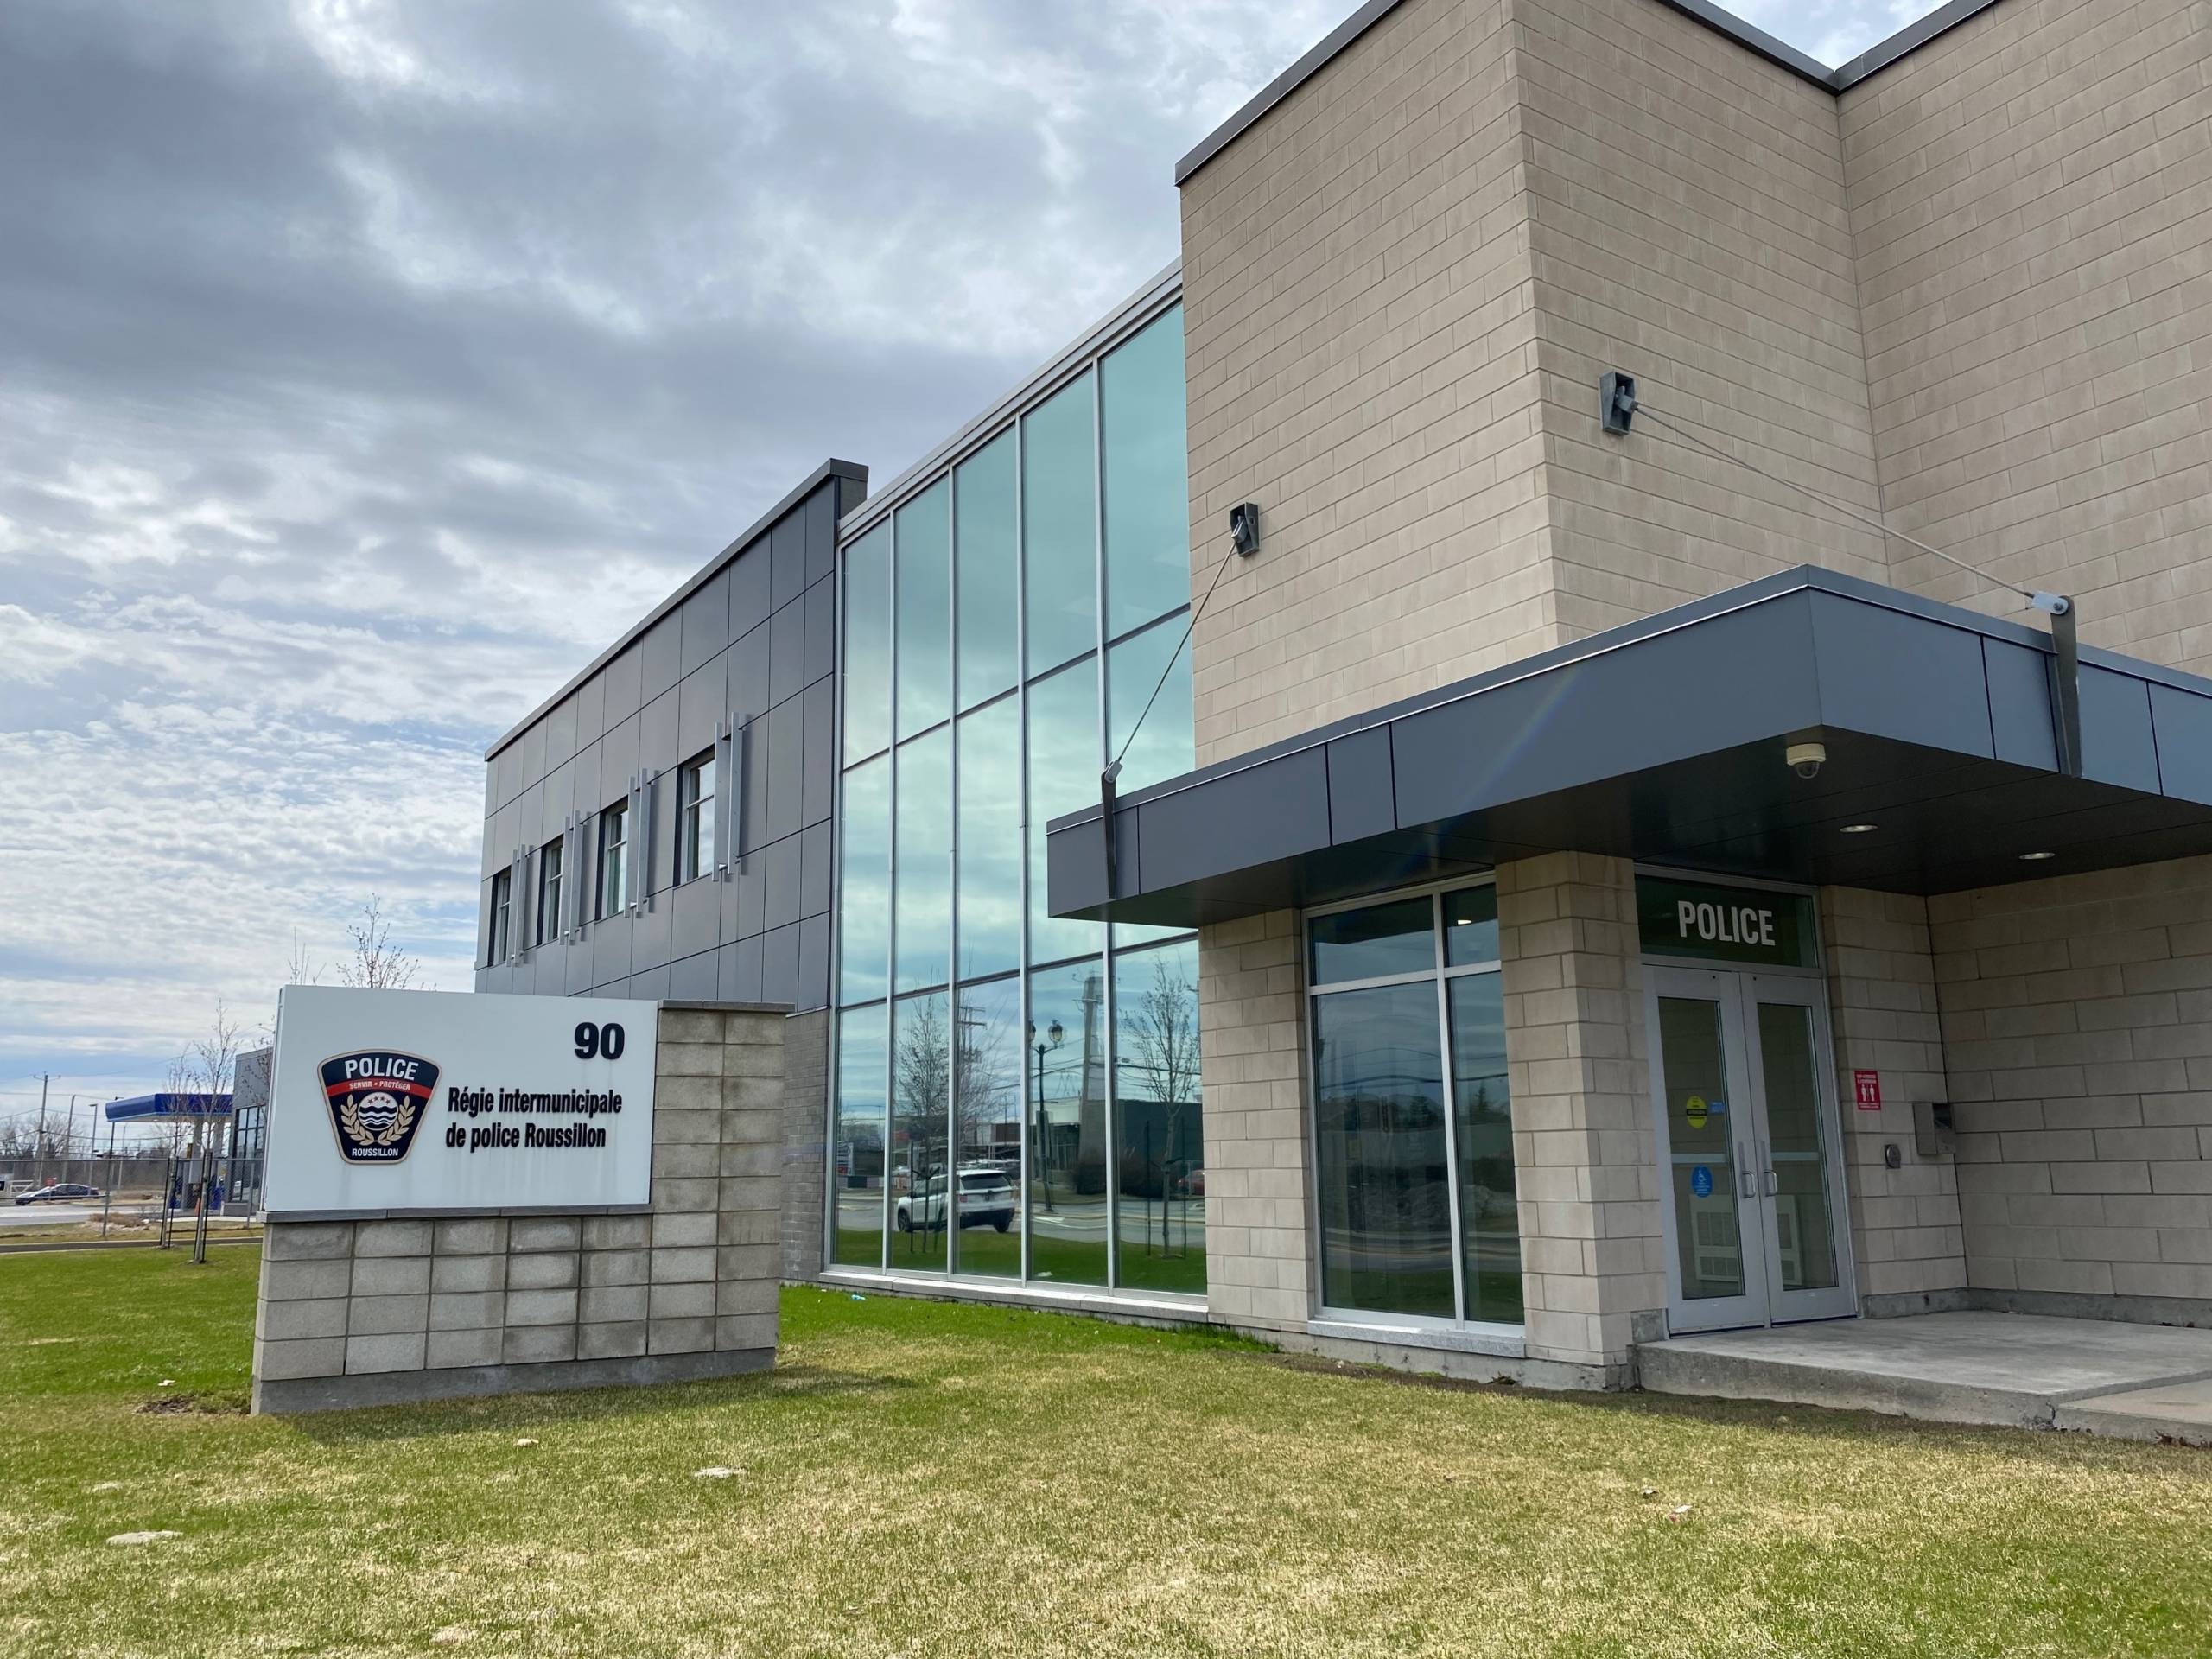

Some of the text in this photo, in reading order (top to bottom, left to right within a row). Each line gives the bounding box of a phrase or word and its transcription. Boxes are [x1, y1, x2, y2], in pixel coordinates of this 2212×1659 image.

[1677, 900, 1776, 946] POLICE
[574, 1021, 625, 1060] 90
[345, 1058, 419, 1080] POLICE
[349, 1080, 410, 1090] SERVIR PROTÉGER
[448, 1086, 622, 1118] Régie intermunicipale
[446, 1122, 606, 1154] de police Roussillon
